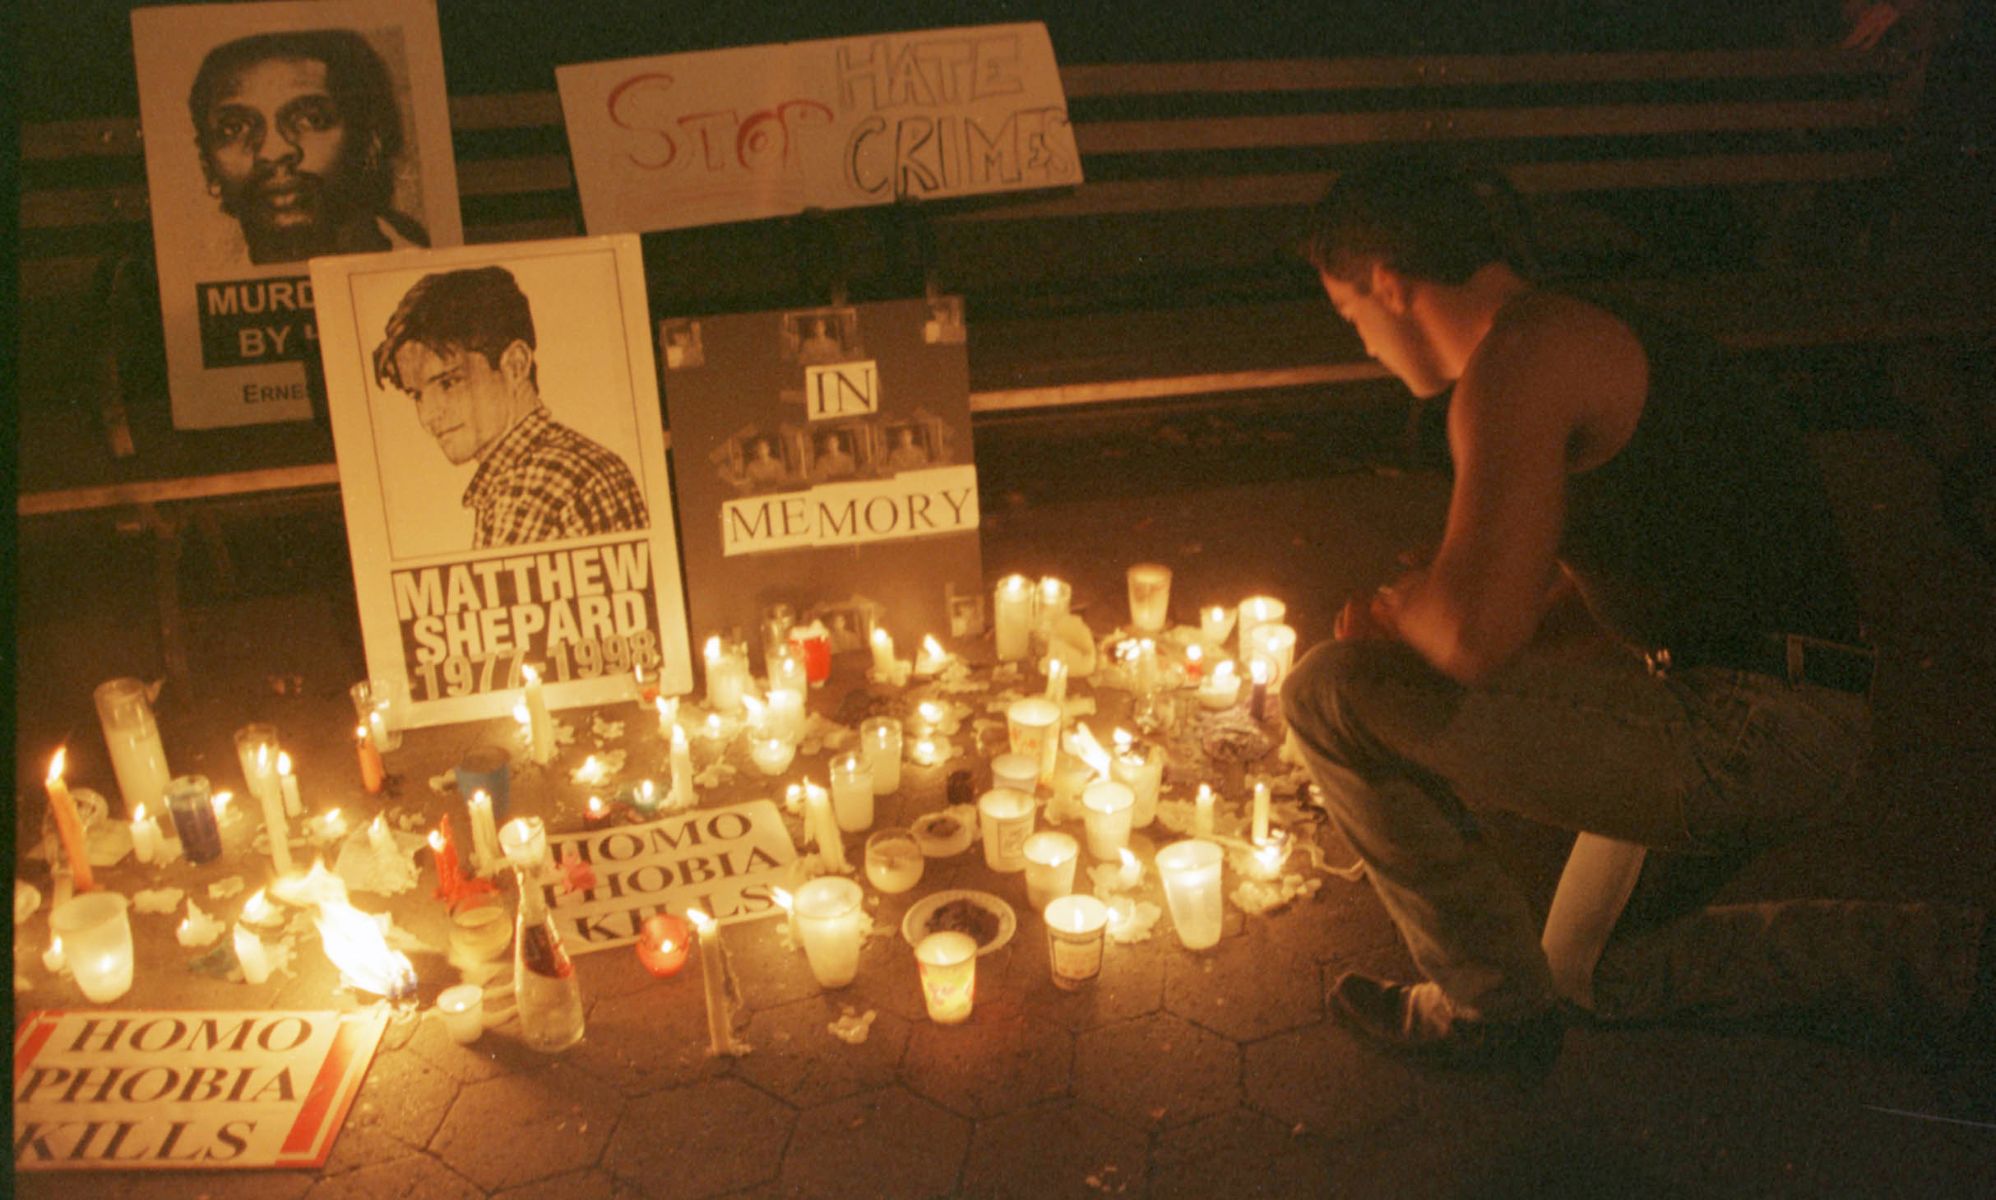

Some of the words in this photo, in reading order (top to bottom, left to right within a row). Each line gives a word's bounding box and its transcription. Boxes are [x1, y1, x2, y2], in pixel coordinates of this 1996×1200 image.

[836, 33, 1024, 112] HATE
[238, 324, 291, 358] BY
[815, 368, 874, 413] IN
[729, 487, 972, 544] MEMORY
[392, 542, 650, 621] MATTHEW
[413, 590, 648, 667] SHEPARD
[414, 629, 660, 701] 1977-1998
[550, 812, 752, 868] HOMO
[575, 882, 775, 943] KILS
[66, 1017, 312, 1052] HOMO
[18, 1066, 297, 1103] PHOBIA
[15, 1119, 257, 1161] KILLS
